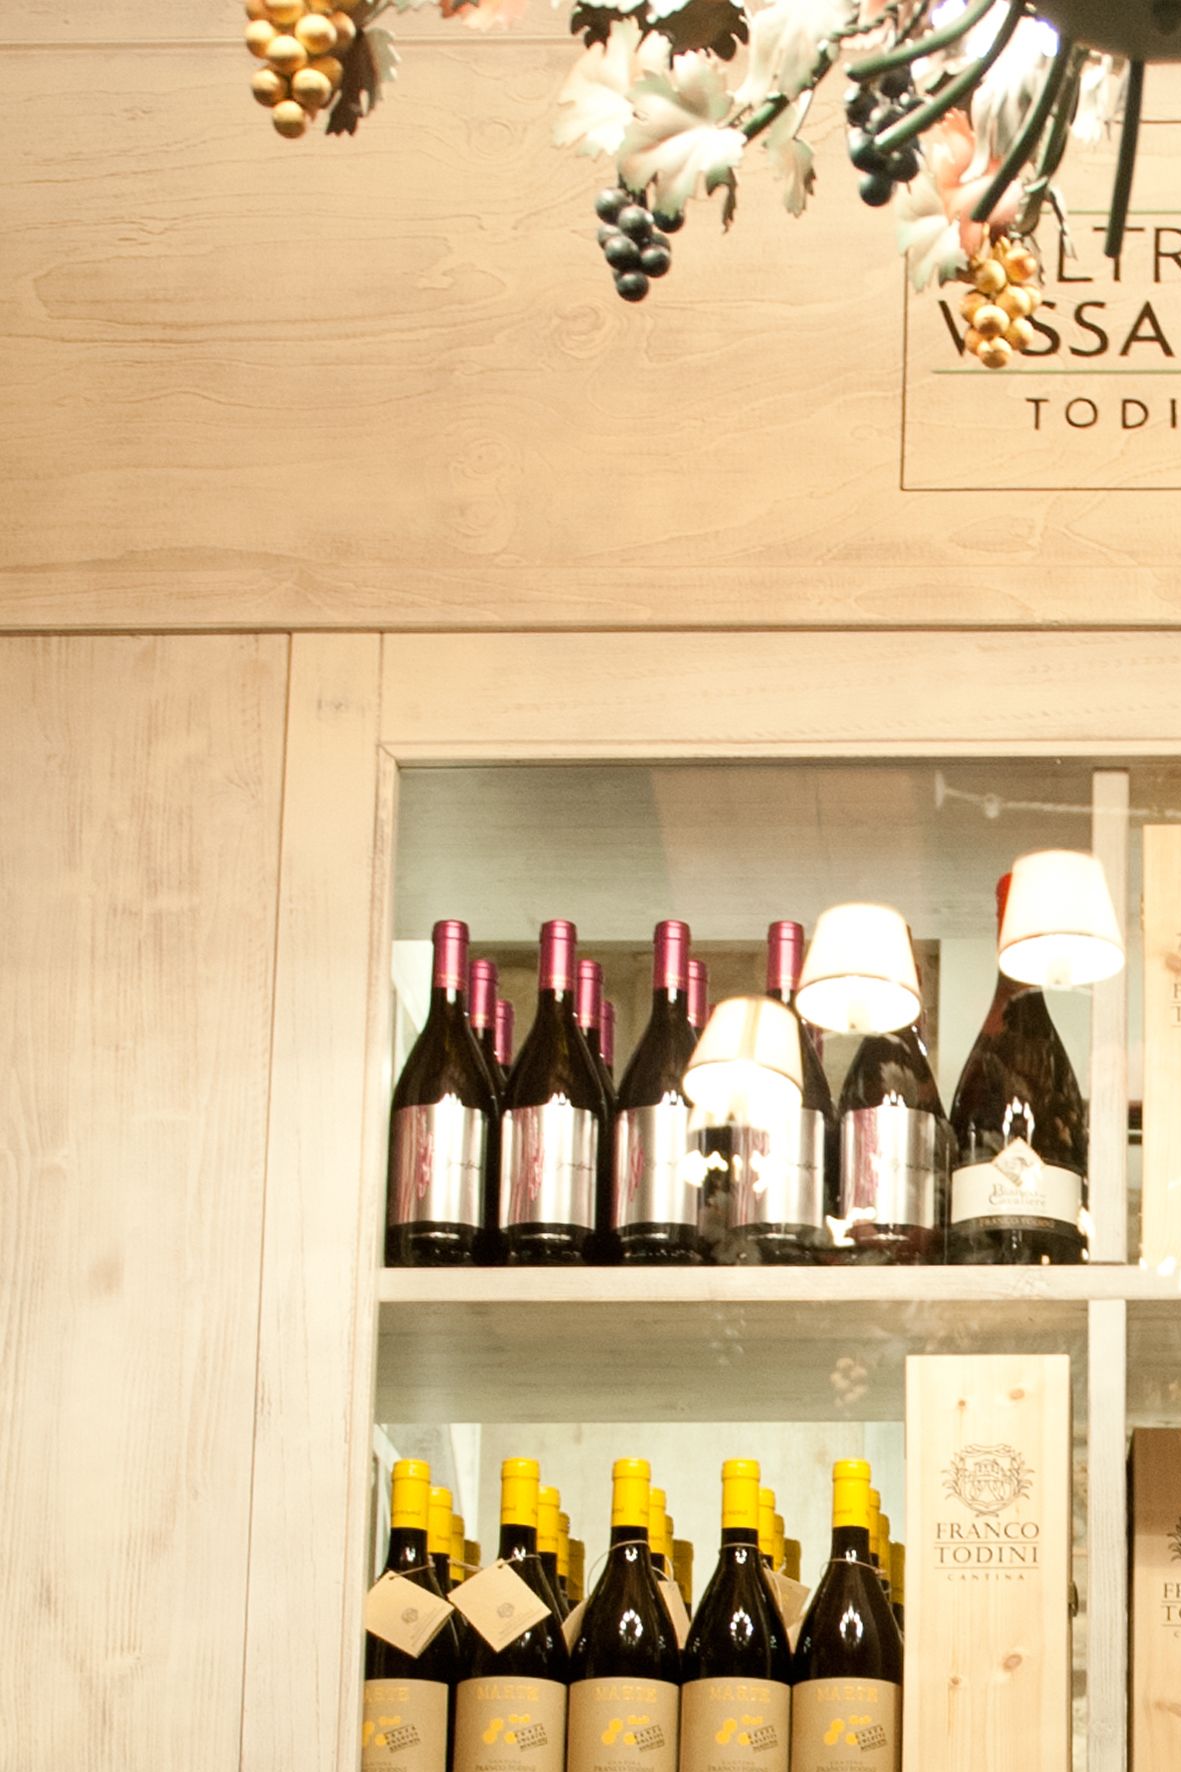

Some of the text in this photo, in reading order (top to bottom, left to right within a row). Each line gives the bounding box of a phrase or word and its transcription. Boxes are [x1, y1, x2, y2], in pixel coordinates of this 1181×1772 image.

[1025, 397, 1178, 431] TODI
[936, 1522, 1040, 1539] FRANCO
[934, 1546, 1038, 1563] TODINI
[947, 1573, 1024, 1581] CANTINA
[365, 1686, 409, 1702] ARTE
[476, 1684, 540, 1702] MARTE
[595, 1685, 657, 1703] MARTE
[710, 1685, 770, 1702] MARTE
[816, 1685, 878, 1703] MARTE
